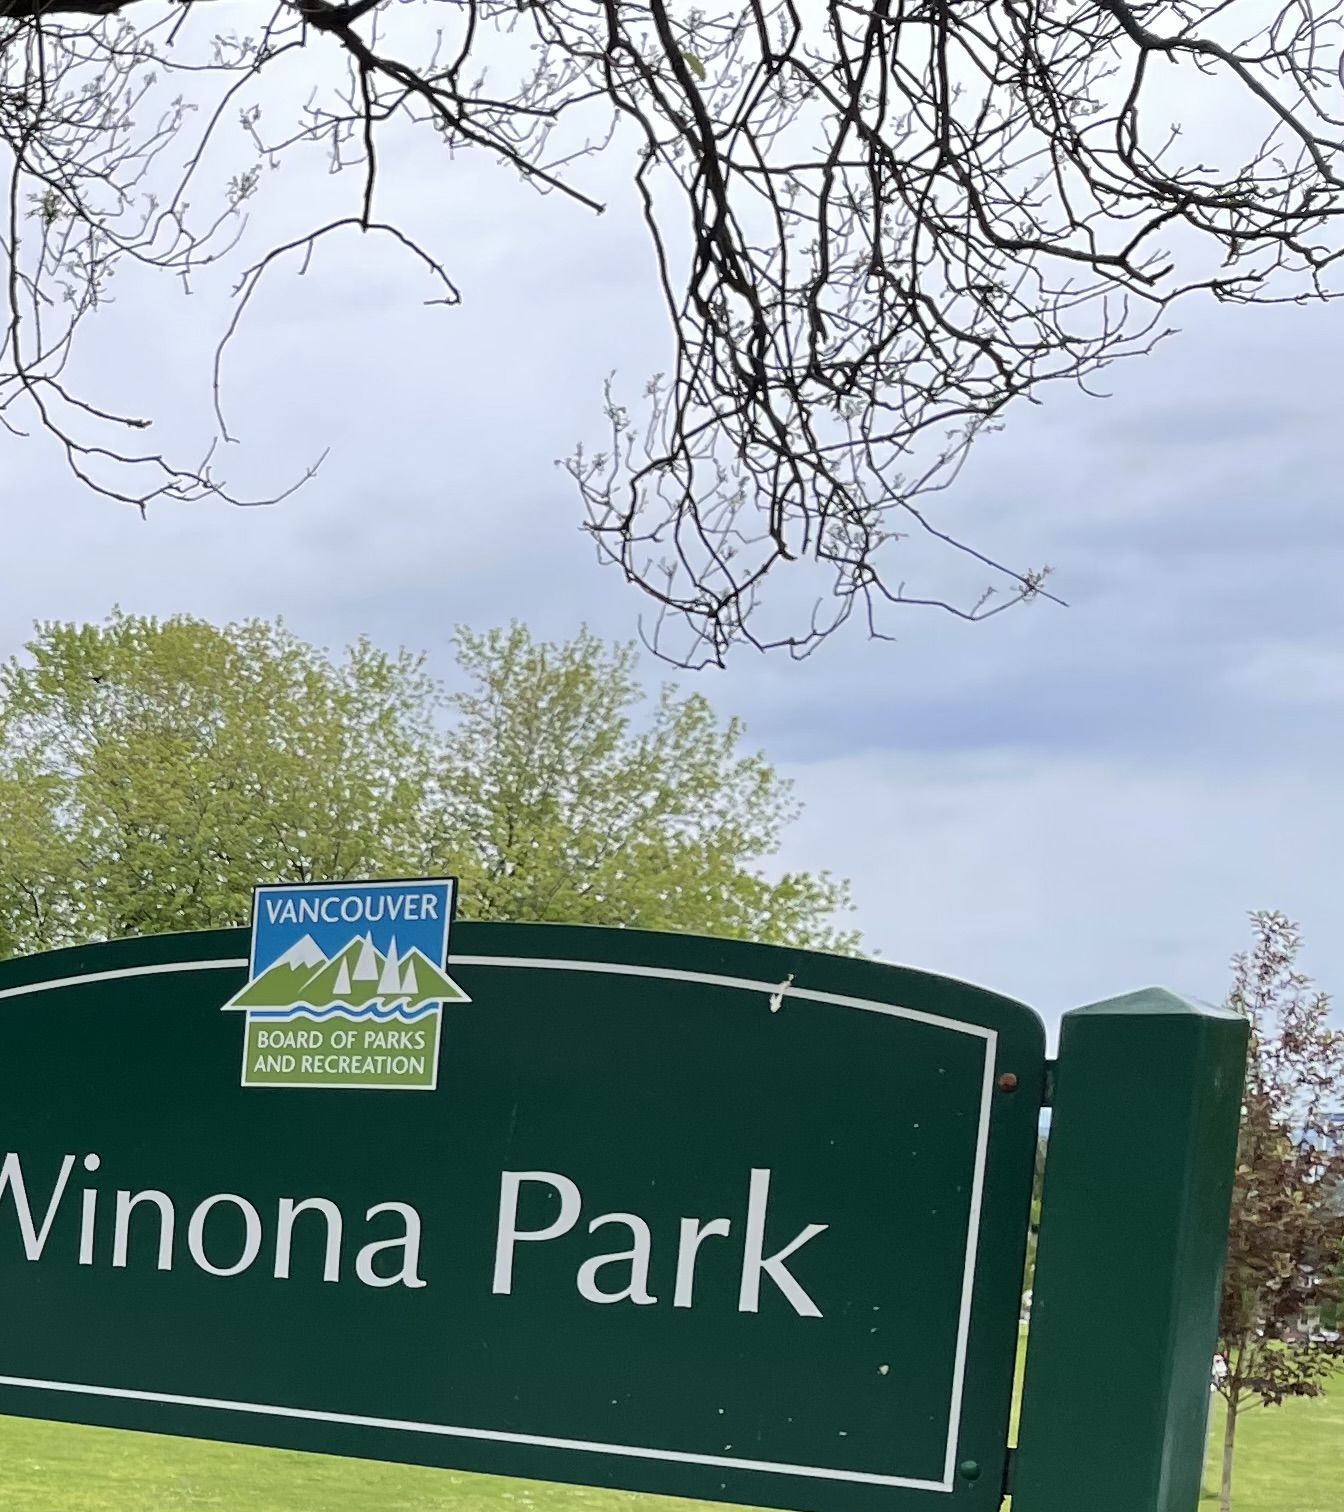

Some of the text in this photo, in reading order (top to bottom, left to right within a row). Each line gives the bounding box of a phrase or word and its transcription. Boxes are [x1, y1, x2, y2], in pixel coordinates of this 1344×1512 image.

[265, 893, 439, 925] VANCOUVER
[257, 1030, 426, 1050] BOARD OF PARKS
[253, 1055, 425, 1075] AND RECREATION
[491, 1168, 830, 1319] Park
